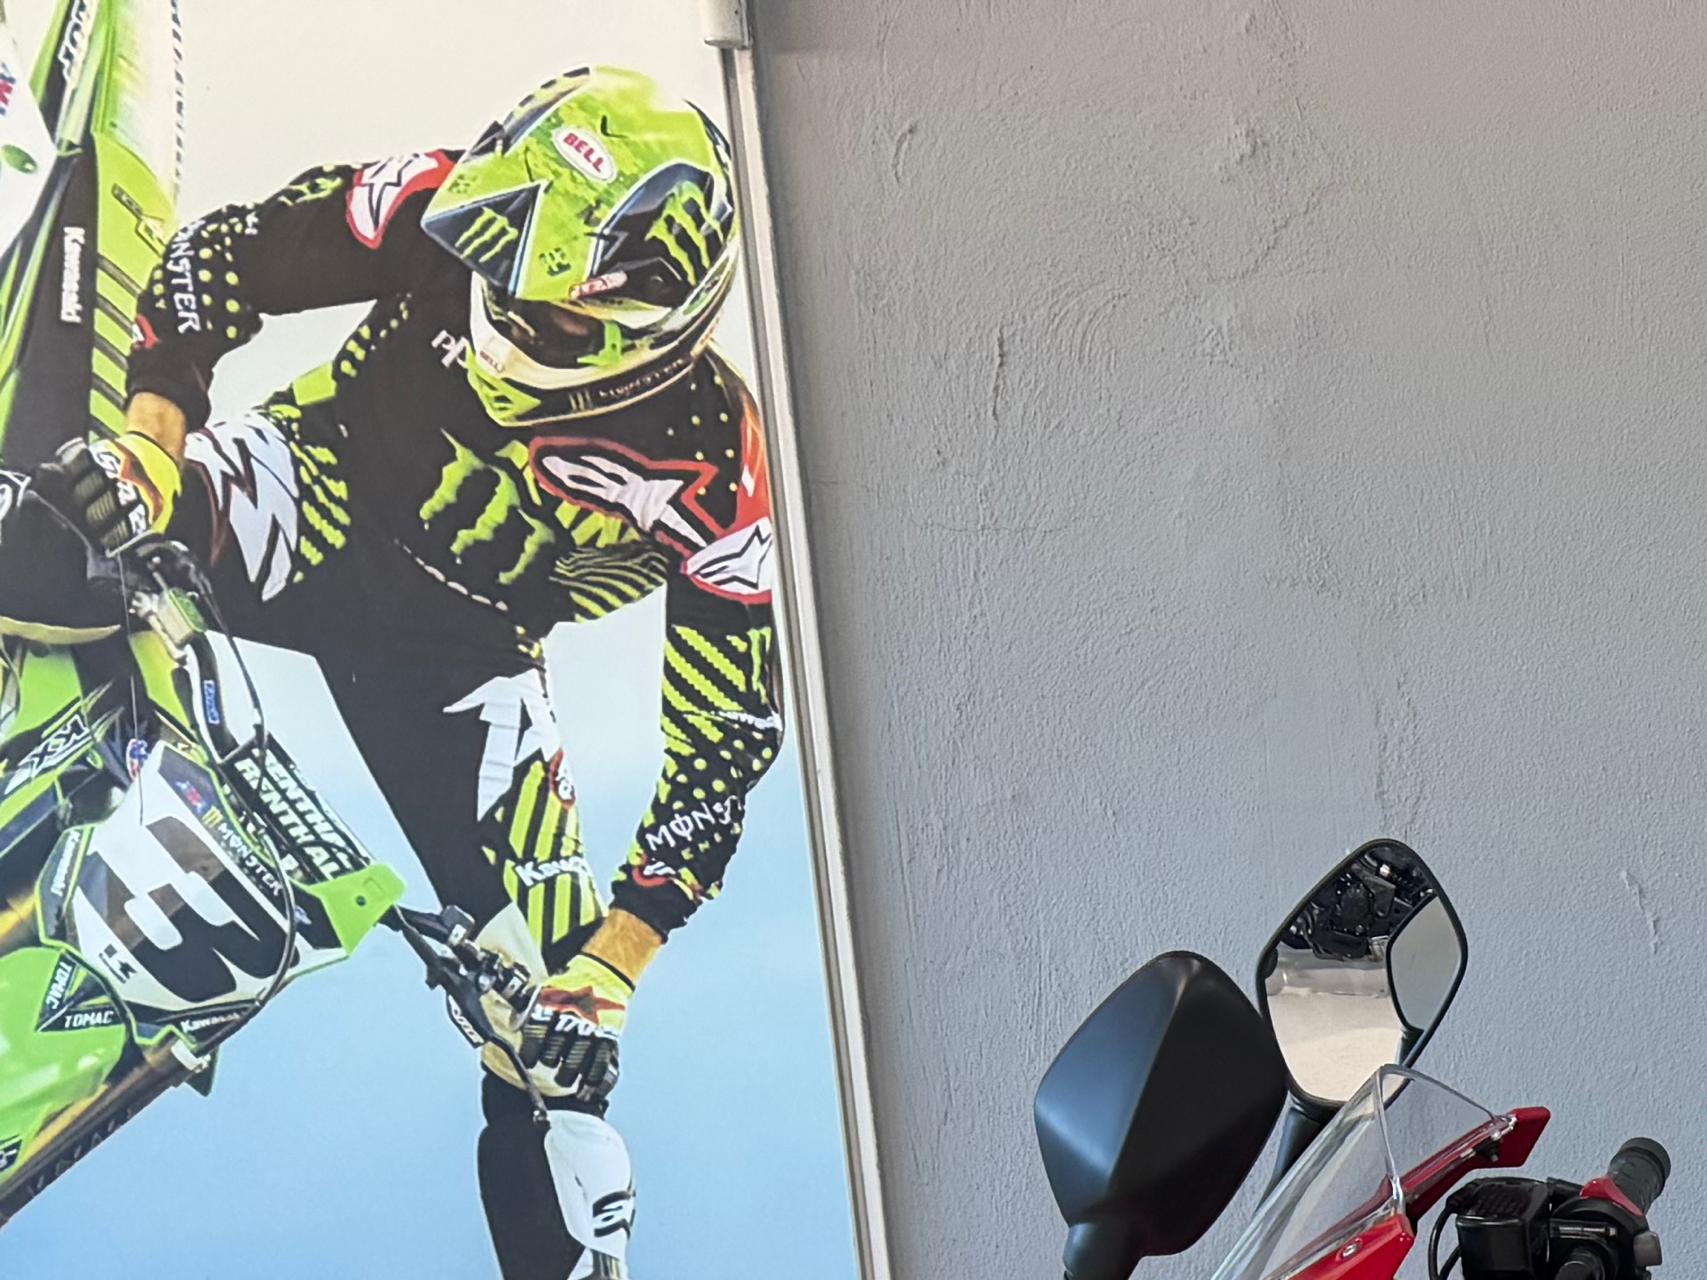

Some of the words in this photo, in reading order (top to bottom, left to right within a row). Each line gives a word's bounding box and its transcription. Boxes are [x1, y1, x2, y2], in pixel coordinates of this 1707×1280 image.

[563, 132, 607, 173] BELL
[163, 219, 202, 335] ONSTER
[64, 1010, 114, 1028] TOMAC
